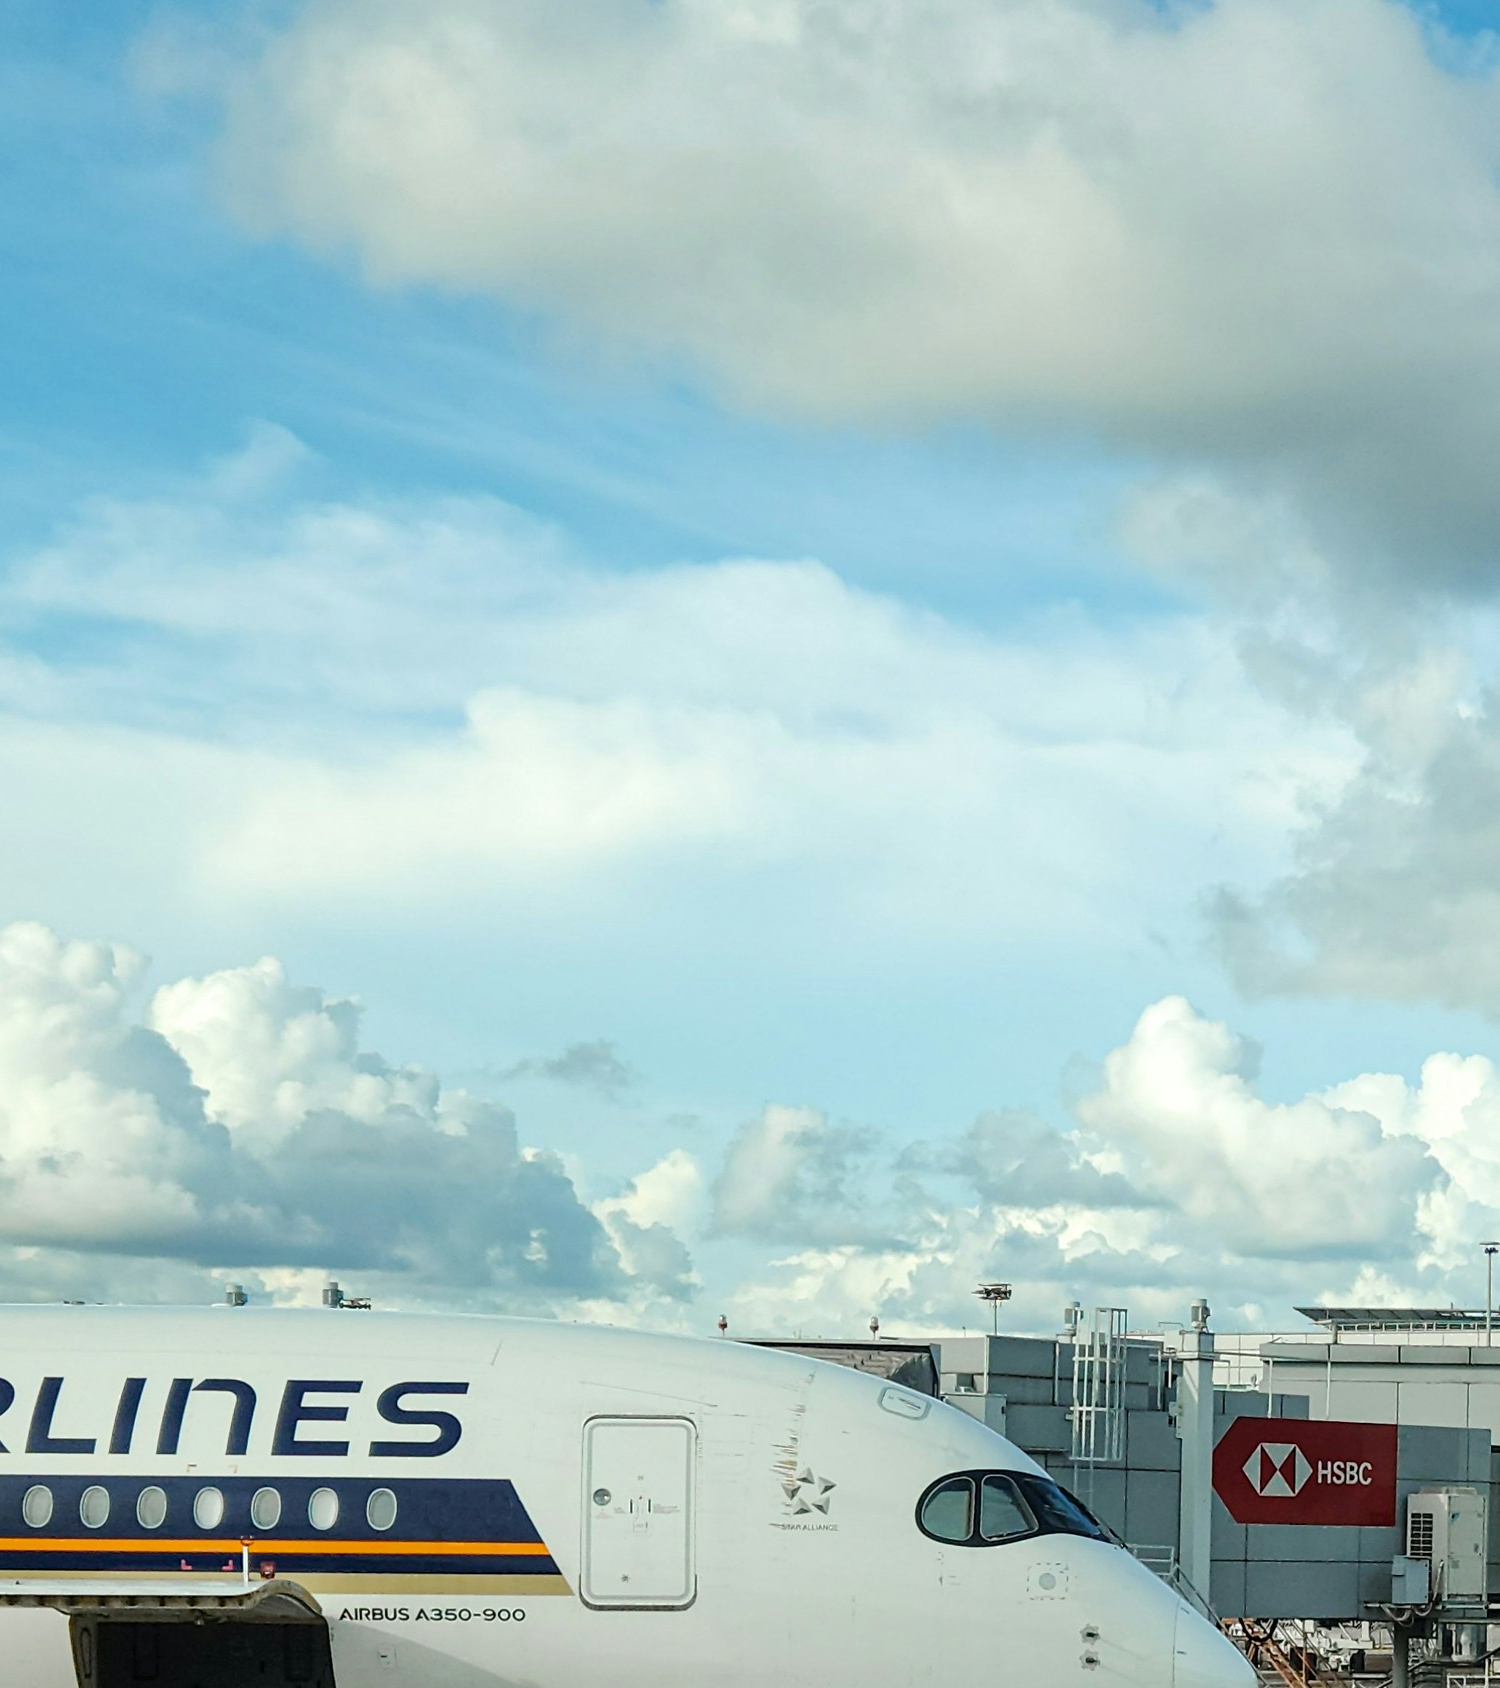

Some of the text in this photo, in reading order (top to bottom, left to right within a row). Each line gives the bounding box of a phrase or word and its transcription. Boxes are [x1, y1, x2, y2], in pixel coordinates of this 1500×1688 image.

[1316, 1461, 1373, 1486] HSBC
[339, 1607, 526, 1622] AIRBUS A350-900
